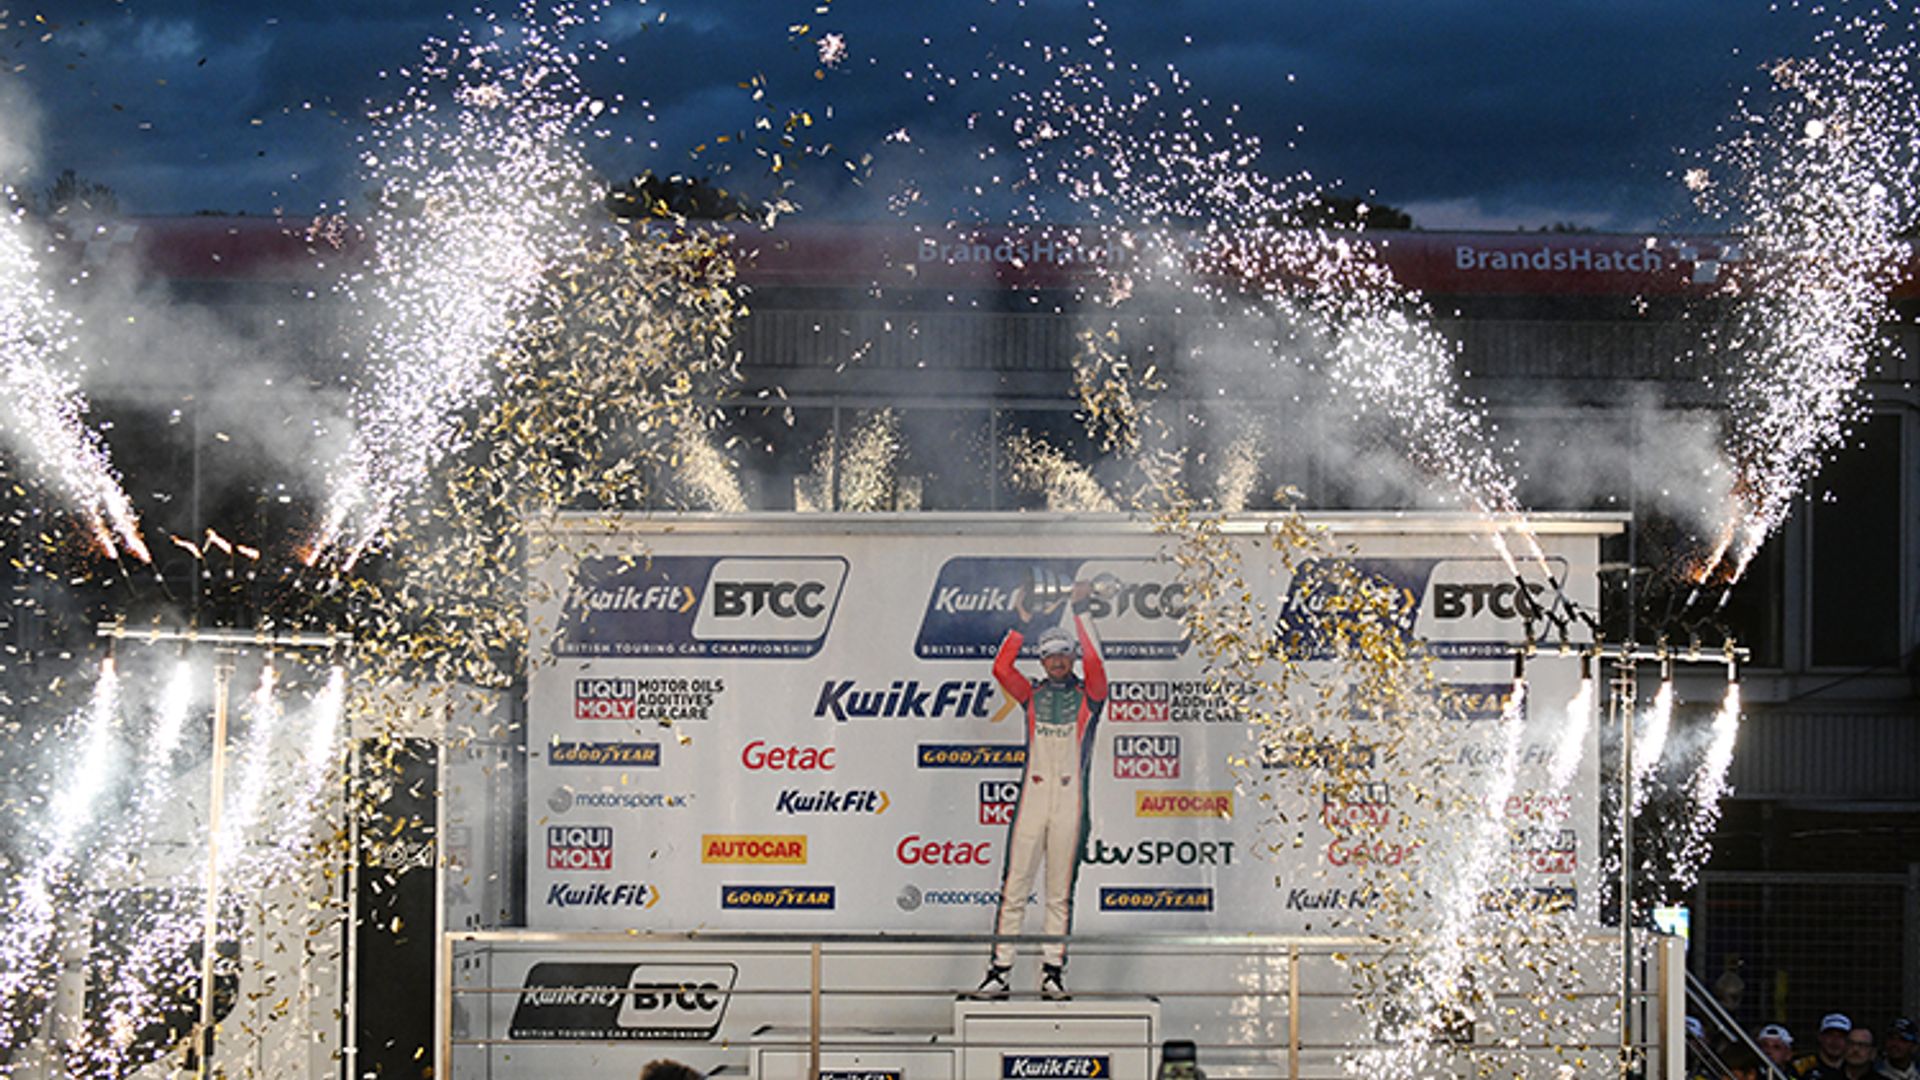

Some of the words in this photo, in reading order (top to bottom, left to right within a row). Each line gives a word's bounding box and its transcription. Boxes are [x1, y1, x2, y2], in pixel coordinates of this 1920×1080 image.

[714, 582, 826, 618] BTCC
[616, 644, 675, 654] TOURING
[679, 644, 706, 654] CAR
[712, 644, 814, 654] CHAMPIONSHIP
[921, 645, 976, 655] BRITISH
[578, 681, 634, 698] LIQUI
[638, 679, 687, 692] MOTOR
[691, 679, 724, 692] OILS
[1111, 684, 1166, 701] LIQUI
[638, 694, 713, 706] ADDITIVES
[578, 701, 634, 717] MOLY
[637, 707, 667, 720] CAR
[670, 707, 707, 720] CARE
[1111, 703, 1168, 719] MOLY
[1171, 709, 1201, 722] CAR
[742, 741, 836, 770] Getac
[1116, 738, 1177, 756] LIQUI
[1116, 760, 1178, 777] MOLY
[576, 792, 663, 808] motorsport
[983, 784, 1019, 803] LIQ
[1141, 796, 1229, 812] AUTOCAR
[983, 805, 1014, 823] MO
[551, 828, 609, 847] LIQUI
[551, 849, 609, 867] MOLY
[707, 841, 803, 858] AUTOCAR
[897, 836, 992, 865] Getac
[1137, 841, 1235, 865] SPORT
[726, 888, 831, 908] GOODYEAR
[925, 890, 1001, 905] motorspo
[1105, 890, 1210, 907] GOODYEAR
[633, 983, 720, 1010] BTCC
